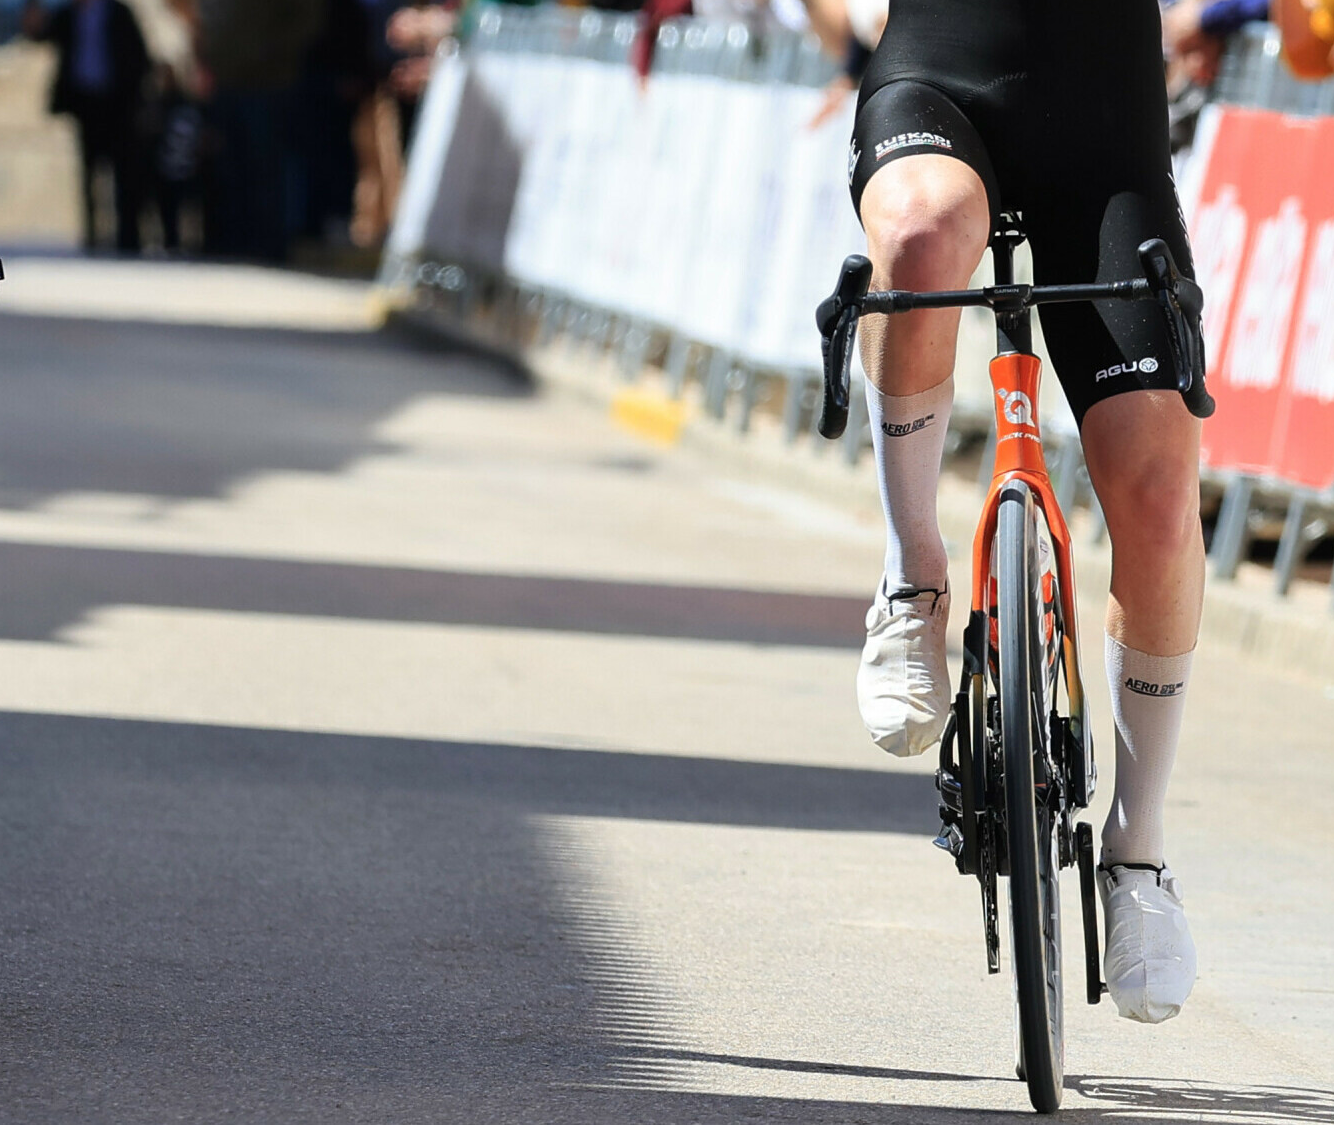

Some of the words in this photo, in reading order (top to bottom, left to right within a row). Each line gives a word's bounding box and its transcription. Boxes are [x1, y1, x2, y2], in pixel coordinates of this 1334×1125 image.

[874, 131, 953, 153] EUSKADI
[993, 287, 1020, 295] GARMIN
[882, 421, 911, 434] AERO
[1124, 677, 1159, 694] AERO
